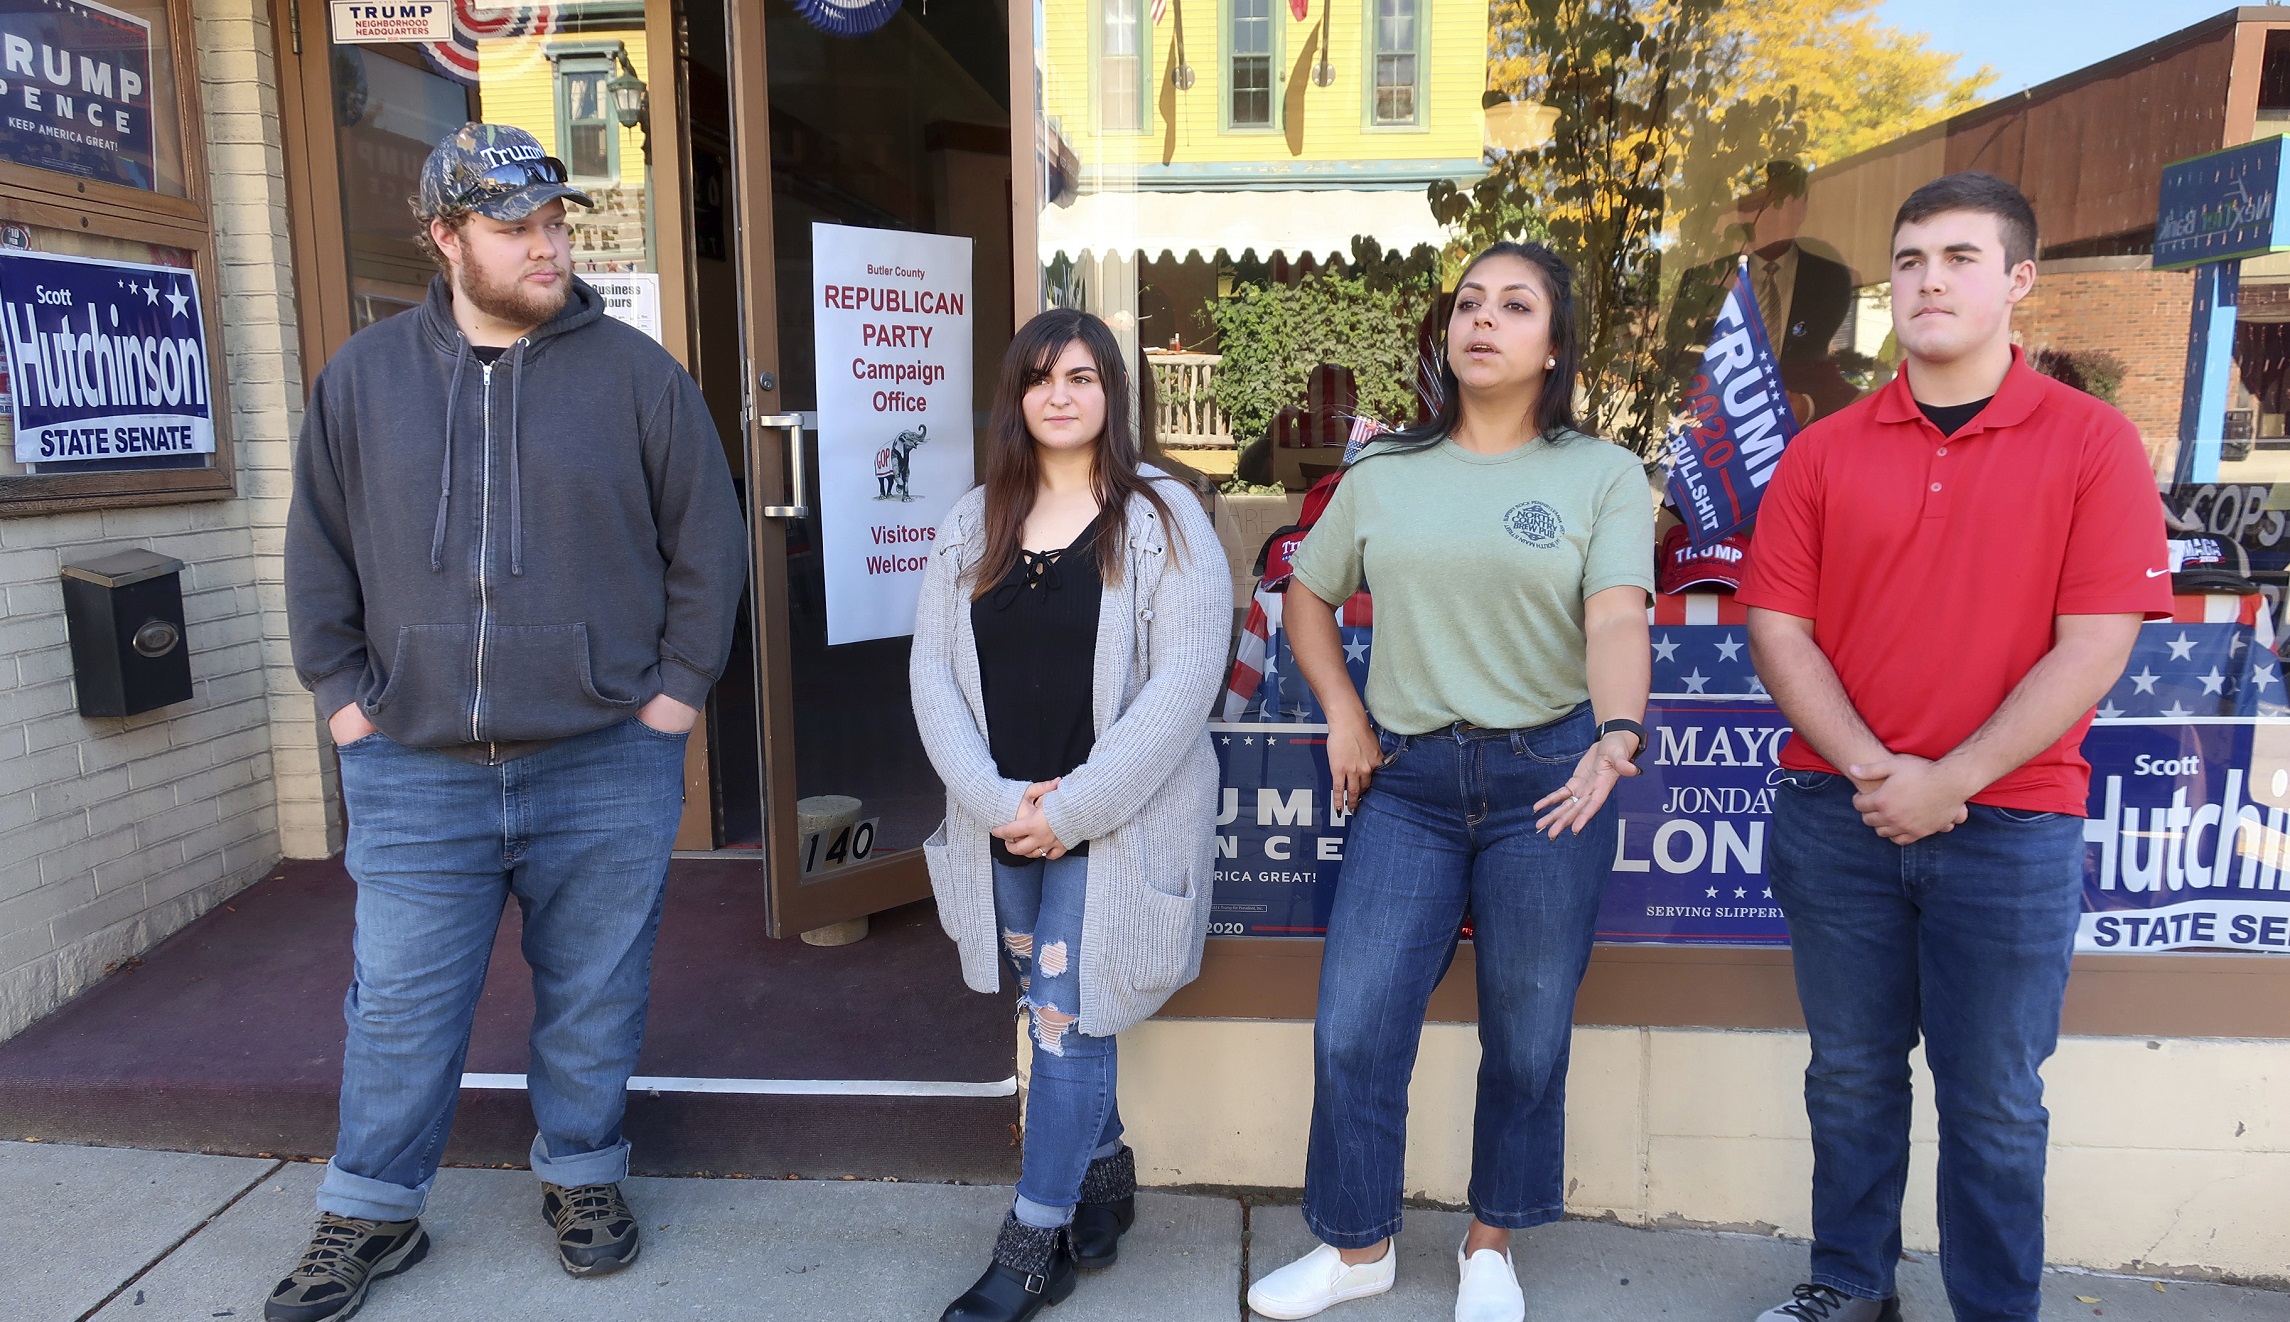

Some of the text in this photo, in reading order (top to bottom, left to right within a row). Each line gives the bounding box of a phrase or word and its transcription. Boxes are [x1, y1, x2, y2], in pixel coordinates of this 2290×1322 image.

[349, 5, 433, 19] TRUMP
[355, 19, 429, 28] NEIGHBORHOOD
[355, 27, 430, 36] HEADQUARTERS
[4, 32, 143, 104] RUMP
[8, 116, 119, 152] KEEP AMERICA GREAT!
[867, 264, 926, 280] Butler County
[36, 284, 73, 306] Scott
[824, 284, 964, 316] REPUBLICAN
[862, 323, 933, 348] PARTY
[6, 302, 205, 408] Hutchinson
[852, 357, 945, 386] Campaign
[872, 390, 927, 412] Office
[1703, 291, 1785, 489] TRUM
[40, 425, 193, 457] STATE SENATE
[876, 447, 891, 470] GOP
[1669, 435, 1719, 531] BULLSHIT
[1511, 516, 1557, 532] COUNTRY
[1516, 511, 1554, 525] NORTH
[2191, 484, 2286, 547] COPS
[870, 524, 936, 545] Visitors
[1513, 522, 1538, 533] BREW
[1539, 527, 1555, 539] PUB
[2184, 538, 2222, 557] MAGA
[866, 554, 928, 575] Welco
[1654, 726, 1793, 767] MAY
[2134, 754, 2200, 776] Scott
[1216, 787, 1353, 827] UMP
[1662, 786, 1778, 814] JONDA
[2083, 768, 2290, 893] Hutchi
[806, 822, 874, 873] 140
[1215, 835, 1344, 861] NCE
[1612, 818, 1765, 875] LON
[1214, 871, 1317, 883] RICA GREAT!
[1646, 905, 1712, 918] SERVING
[1206, 922, 1244, 935] 2020
[2094, 912, 2217, 947] STATE
